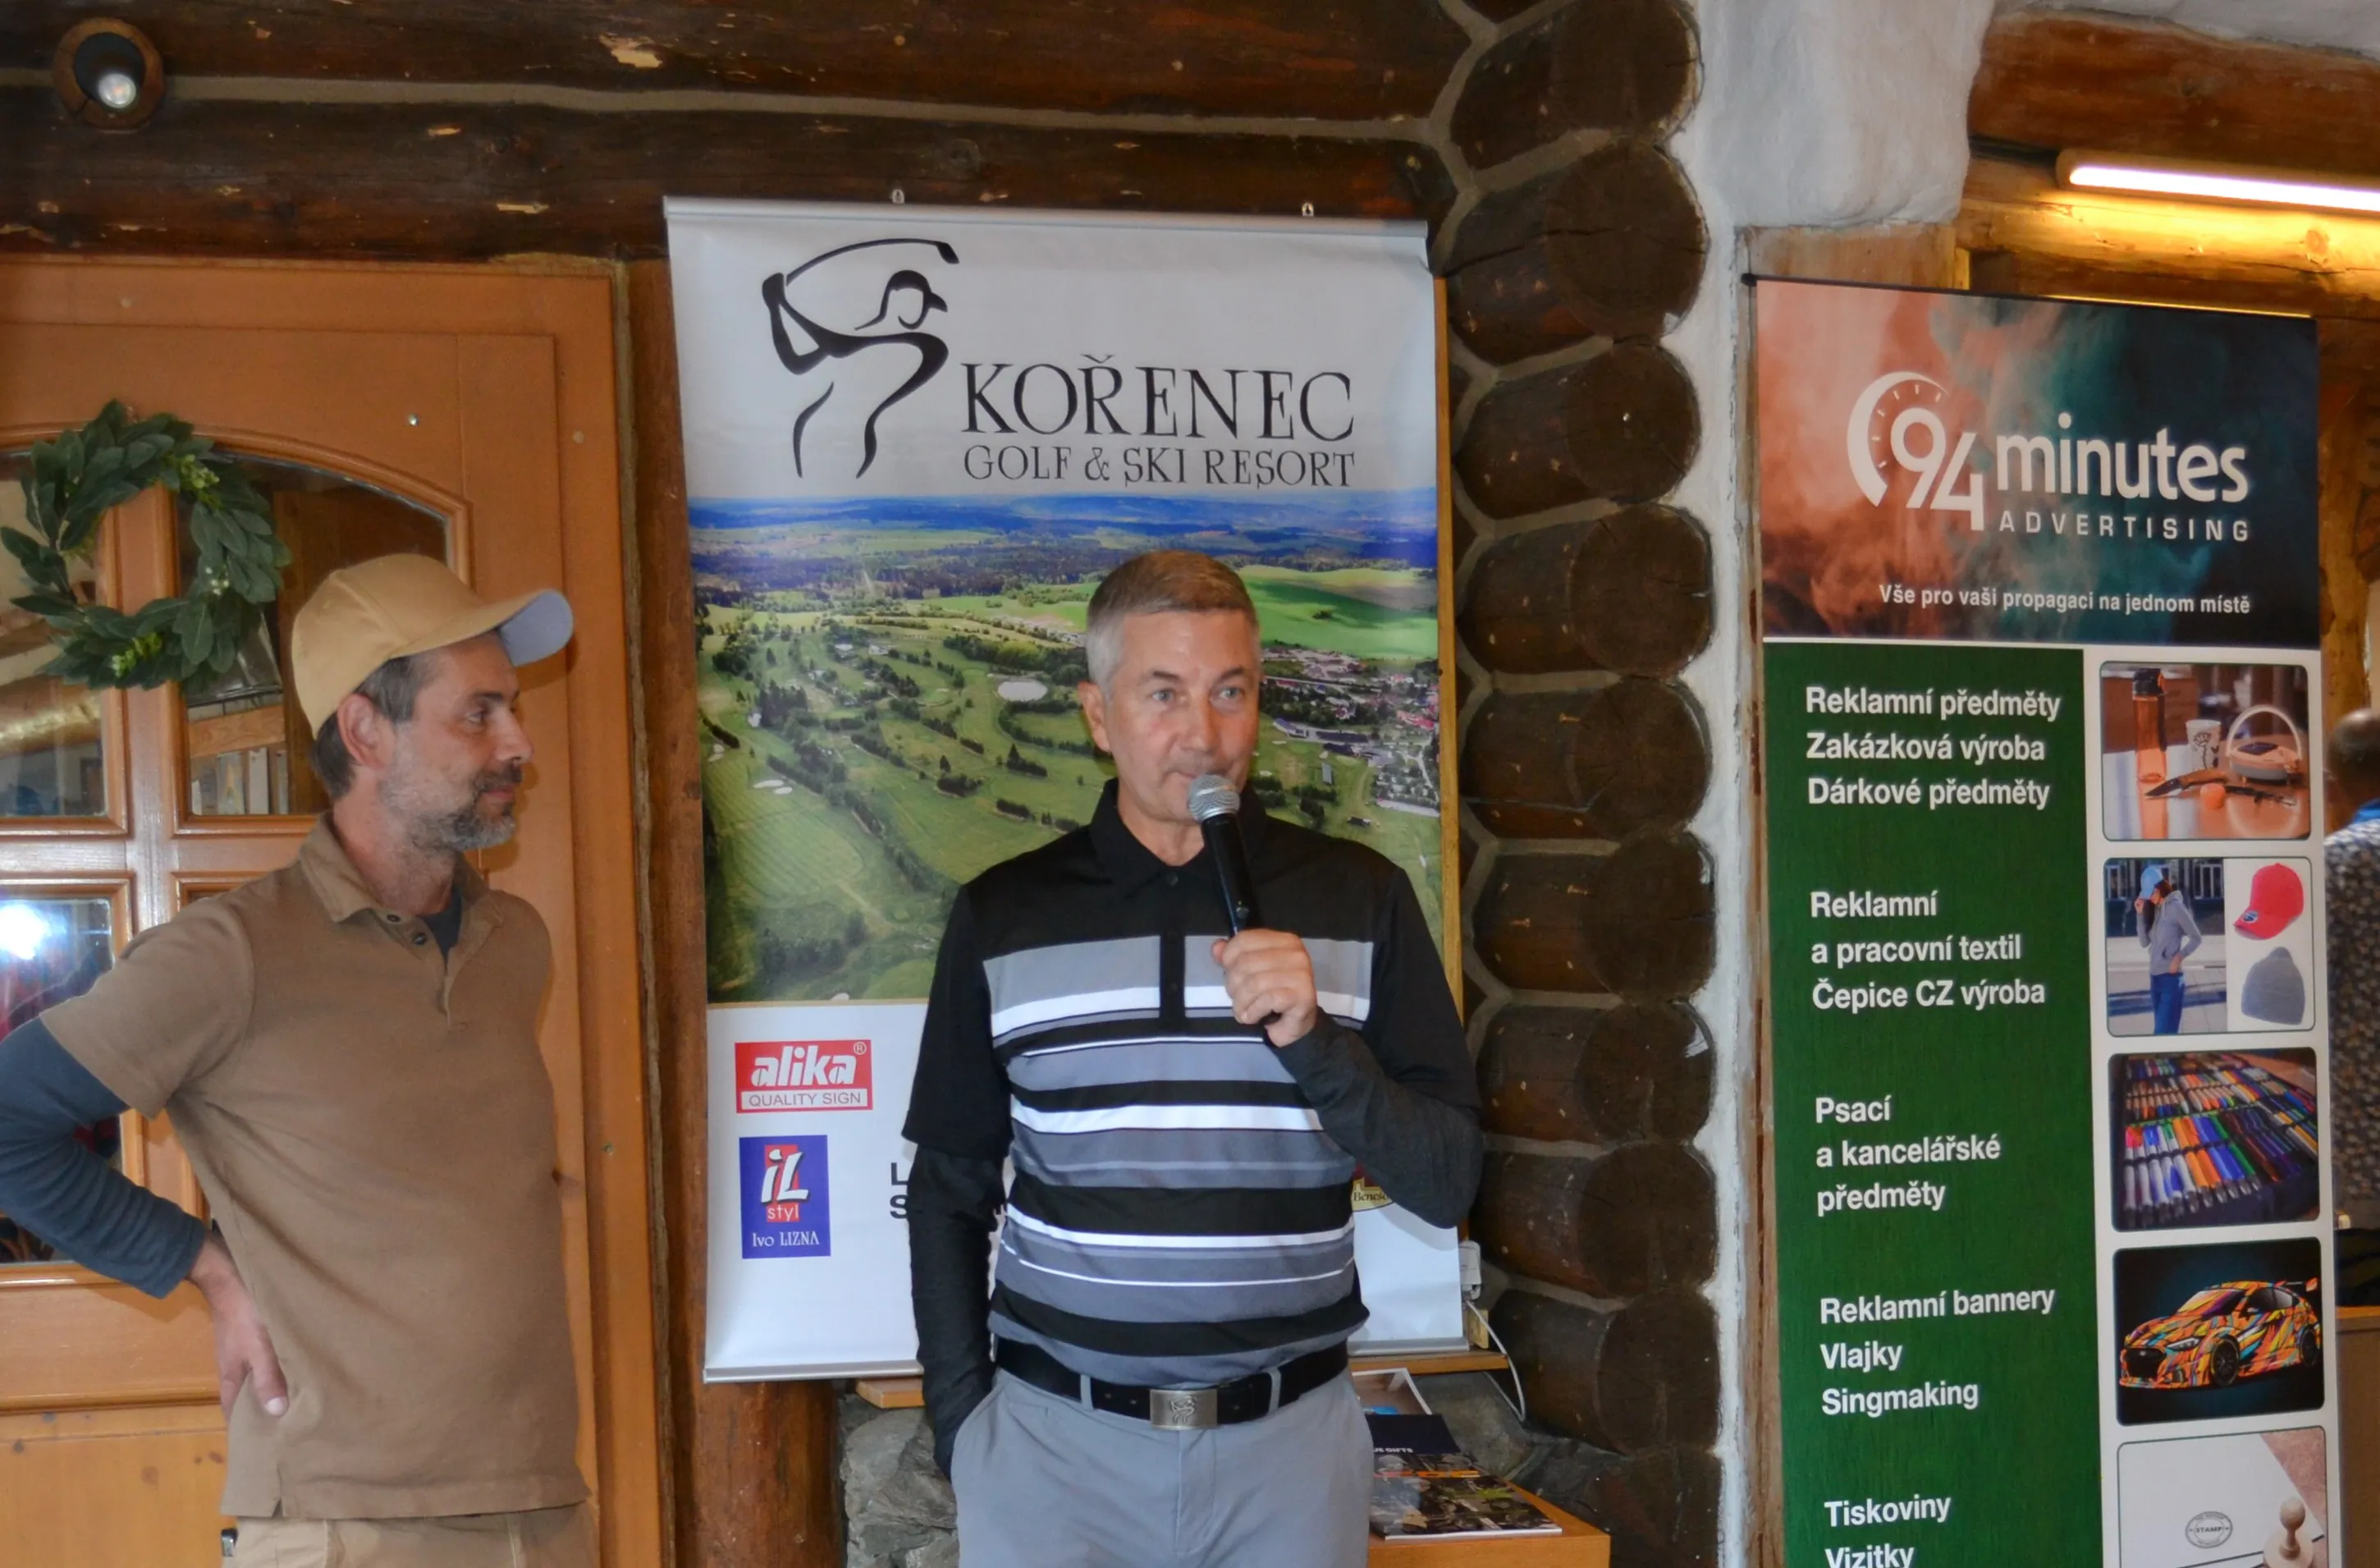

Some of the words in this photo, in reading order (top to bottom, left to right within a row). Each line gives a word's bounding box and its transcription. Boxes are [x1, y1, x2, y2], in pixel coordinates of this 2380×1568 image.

[959, 354, 1355, 442] KOŘENEC
[963, 445, 1073, 480] GOLF
[1083, 446, 1110, 481] &
[1123, 447, 1187, 487] SKI
[1204, 450, 1356, 488] RESORT
[1995, 412, 2249, 503] minutes
[1998, 509, 2250, 542] ADVERTISING
[1879, 583, 1915, 604] Vše
[1921, 589, 1953, 607] pro
[1959, 585, 1997, 606] vaši
[2002, 589, 2094, 612] propagaci
[2099, 595, 2121, 611] na
[2125, 591, 2195, 615] jednom
[2199, 593, 2250, 614] místě
[1806, 686, 1934, 714] Reklamní
[1940, 689, 2061, 722] předměty
[1806, 731, 1952, 759] Zakázková
[1960, 733, 2046, 766] výroba
[1808, 777, 1921, 805] Dárkové
[1929, 778, 2051, 810] předměty
[1810, 890, 1938, 918] Reklamní
[1811, 942, 1828, 964] a
[1837, 934, 1953, 969] pracovní
[1959, 933, 2021, 961] textil
[1812, 977, 1908, 1014] Čepice
[1915, 979, 1954, 1006] CZ
[1961, 979, 2046, 1011] výroba
[748, 1093, 818, 1107] QUALITY
[822, 1092, 861, 1106] SIGN
[1815, 1094, 1893, 1123] Psací
[1816, 1146, 1833, 1167] a
[1842, 1133, 2001, 1167] kancelářské
[767, 1205, 799, 1222] styl
[1817, 1180, 1946, 1217] předměty
[752, 1232, 775, 1248] Ivo
[1820, 1290, 1947, 1324] Reklamní
[1953, 1289, 2056, 1315] bannery
[1819, 1340, 1903, 1373] Vlajky
[1822, 1380, 1980, 1419] Singmaking
[1824, 1493, 1952, 1527] Tiskoviny
[1824, 1543, 1915, 1568] Vizitky
